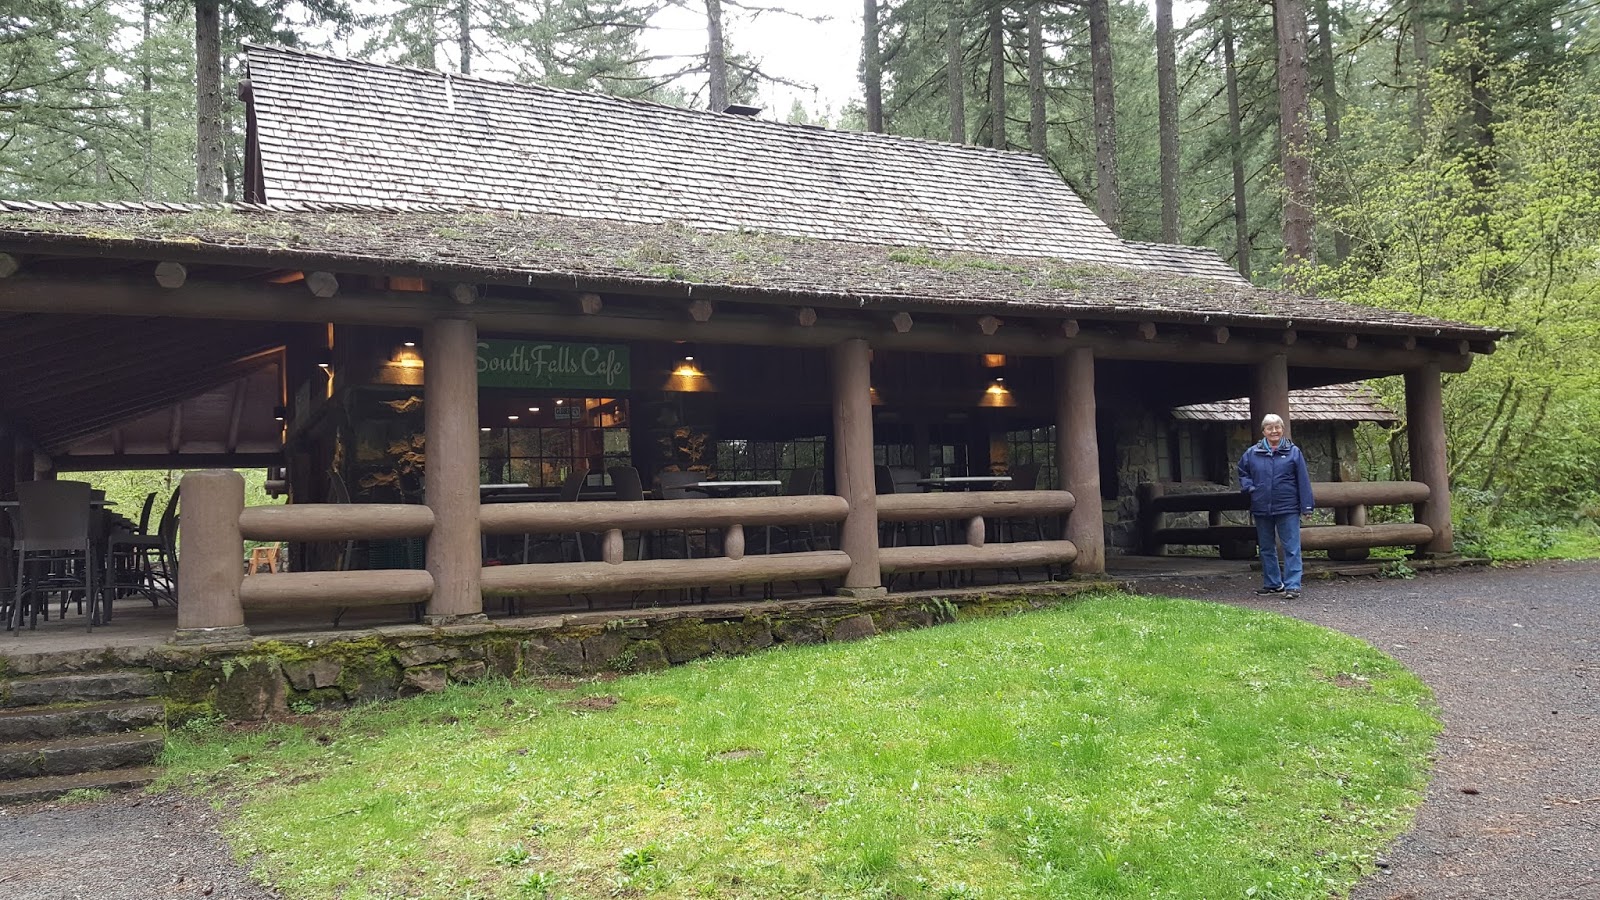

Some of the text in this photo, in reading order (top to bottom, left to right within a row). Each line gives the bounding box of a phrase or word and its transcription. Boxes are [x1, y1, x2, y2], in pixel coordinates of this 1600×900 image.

[477, 342, 623, 385] South Falls Cafe
